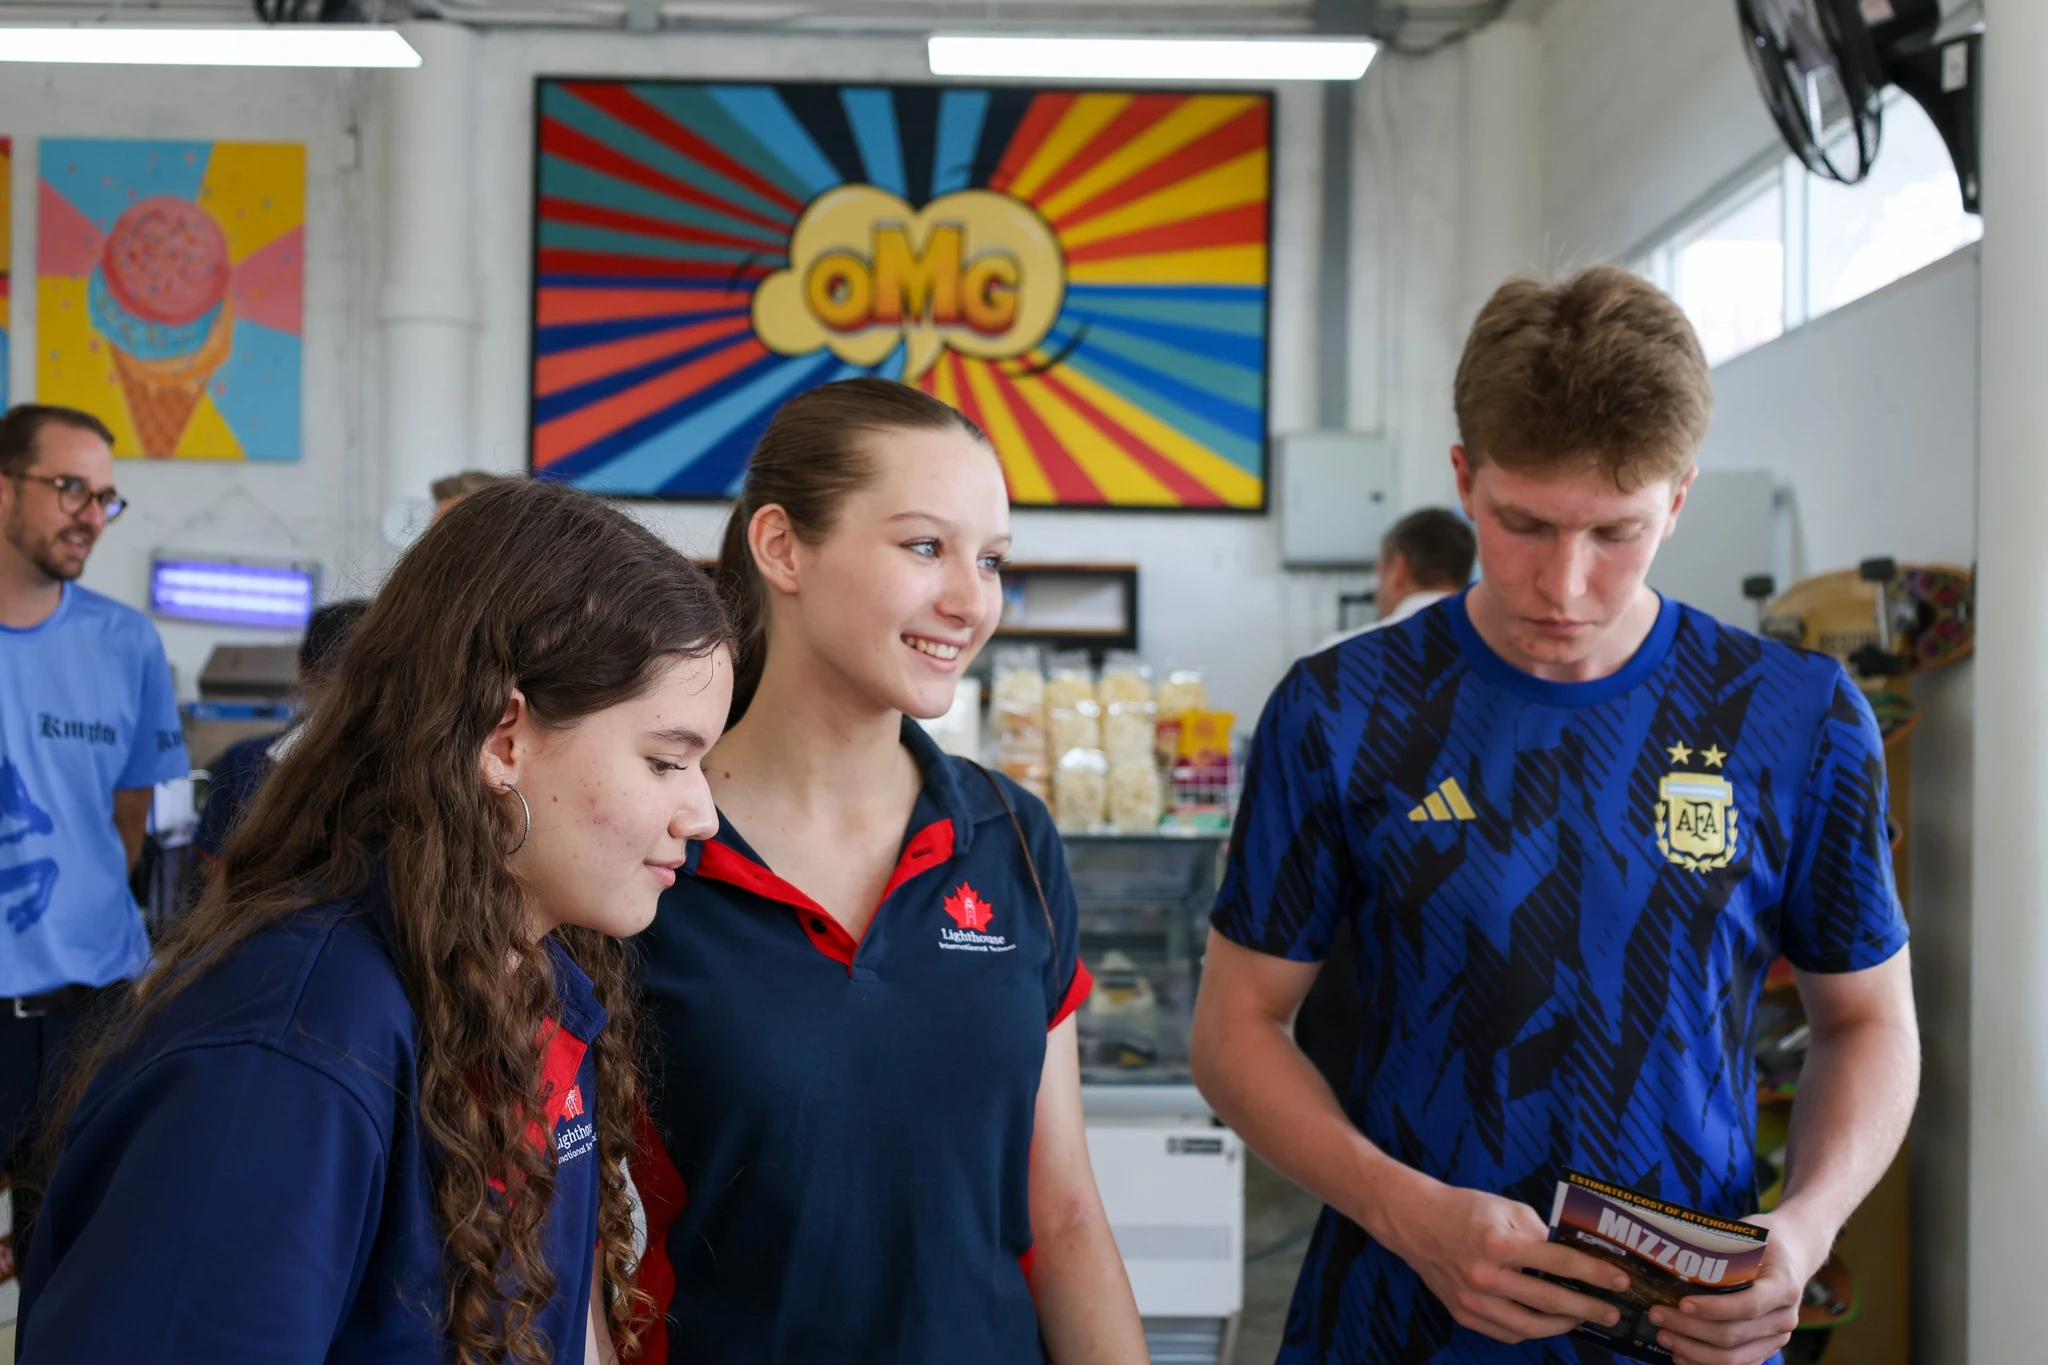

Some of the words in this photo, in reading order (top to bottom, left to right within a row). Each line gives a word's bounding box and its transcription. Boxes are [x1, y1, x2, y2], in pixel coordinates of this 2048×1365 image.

[805, 222, 1021, 336] OMG
[1676, 799, 1718, 841] AFA
[940, 927, 1006, 945] Lighthouse
[1569, 1173, 1634, 1201] ESTIMATED
[1632, 1194, 1664, 1211] COST
[1664, 1205, 1681, 1218] OF
[1680, 1210, 1759, 1237] ATTENDANCE
[1596, 1206, 1730, 1284] MIZZOU
